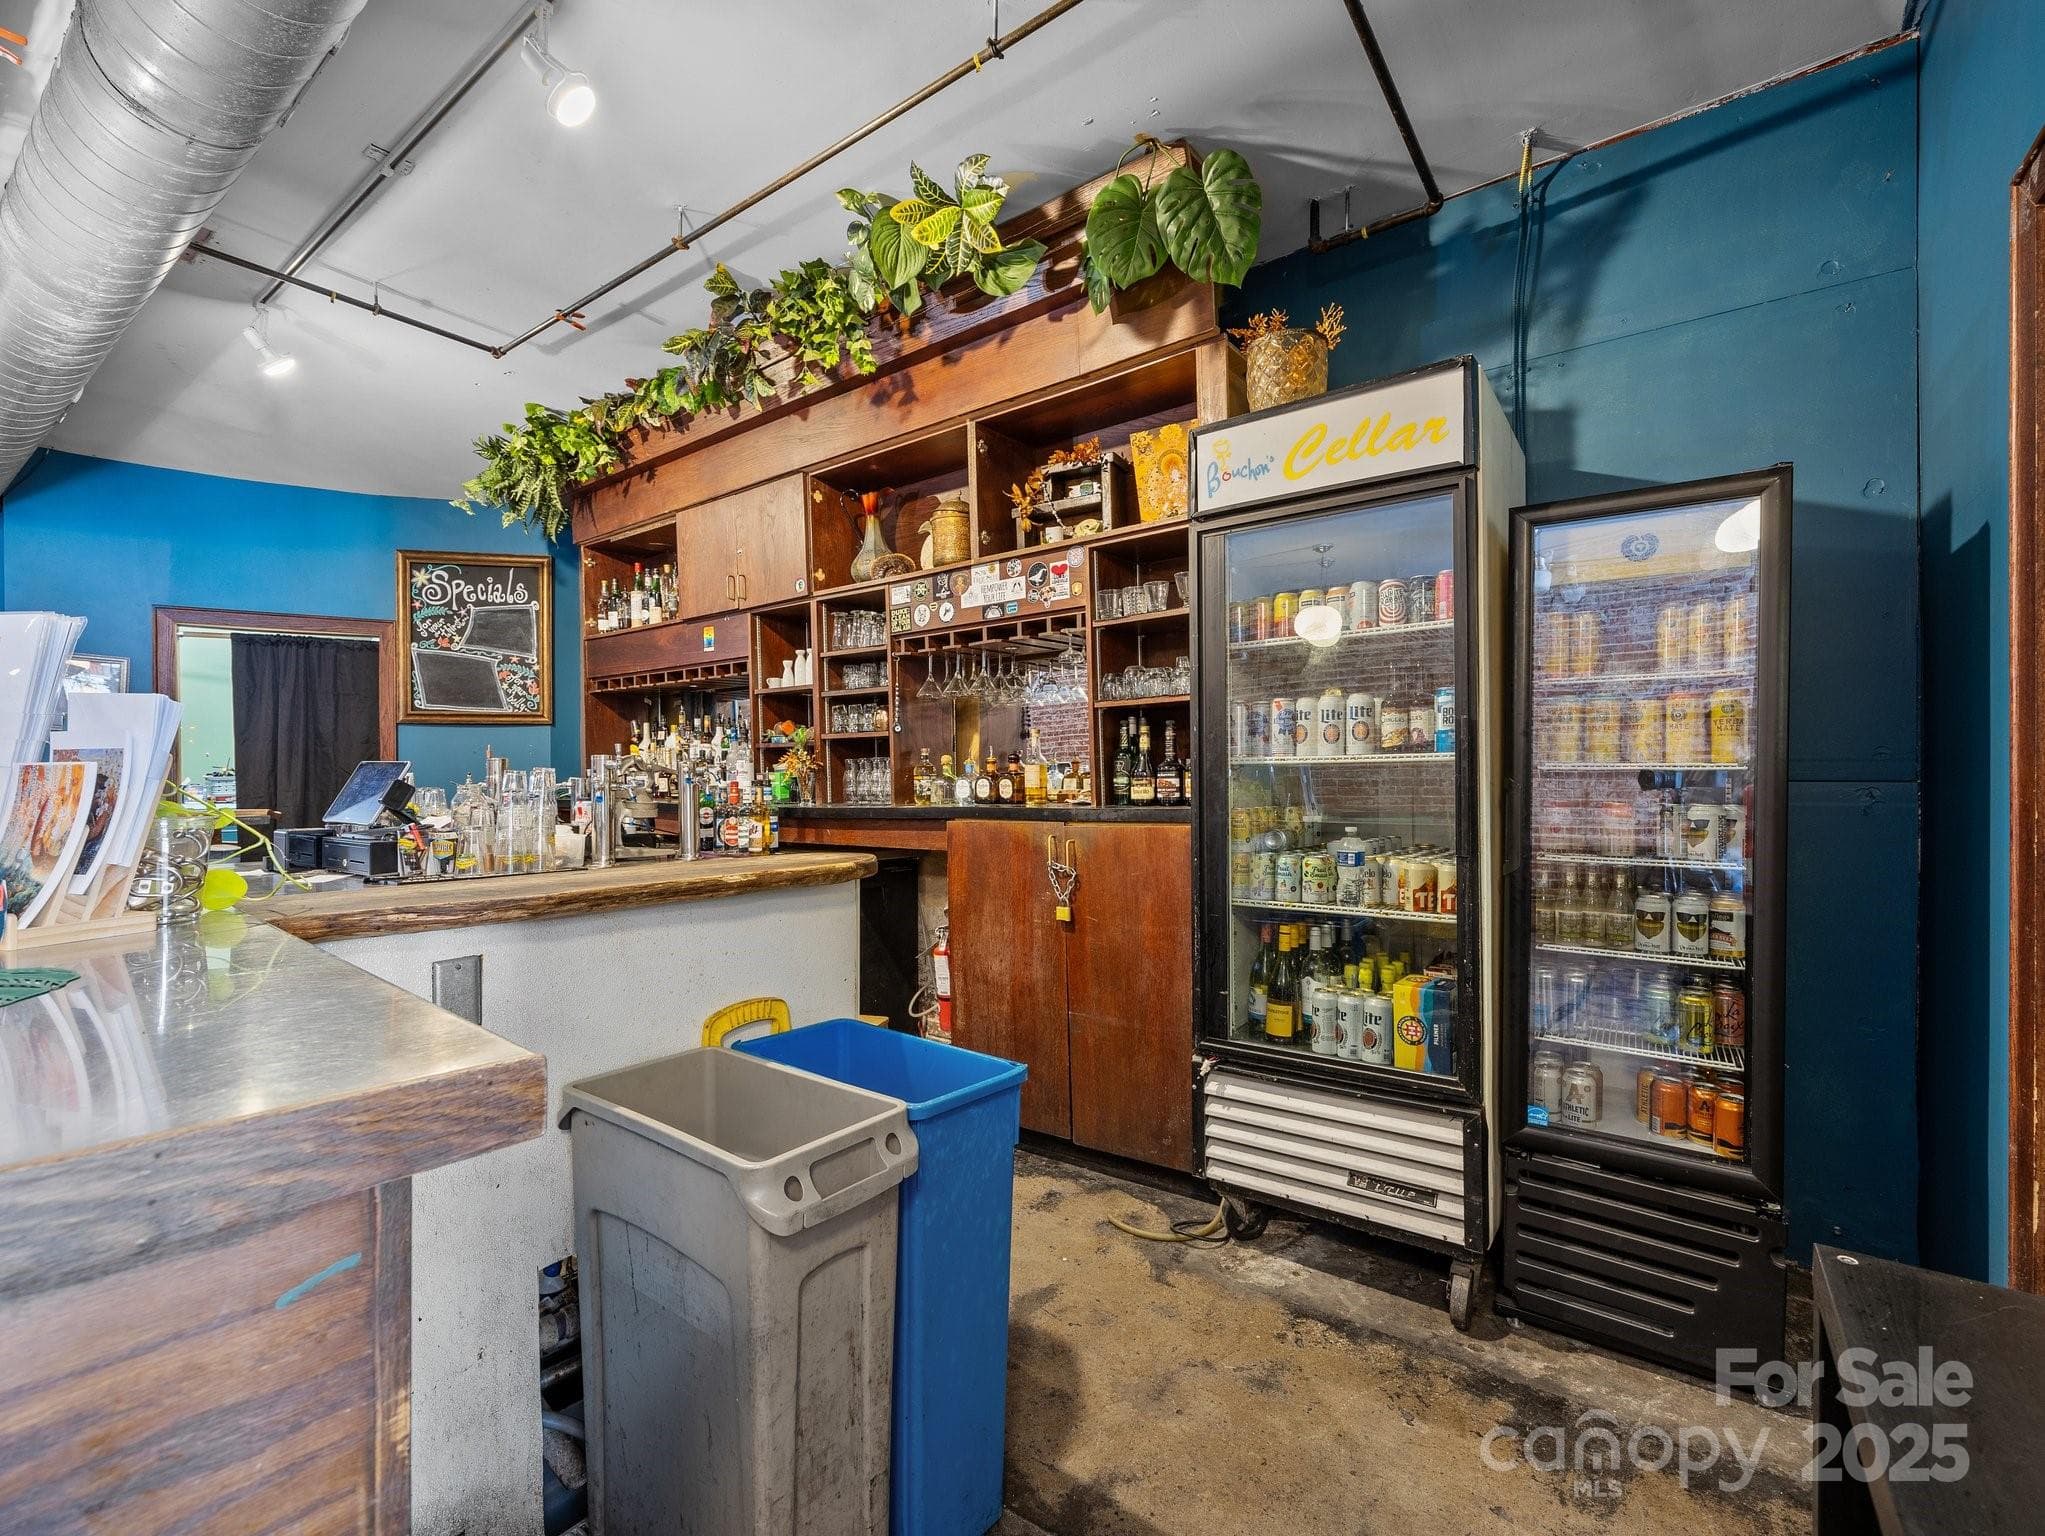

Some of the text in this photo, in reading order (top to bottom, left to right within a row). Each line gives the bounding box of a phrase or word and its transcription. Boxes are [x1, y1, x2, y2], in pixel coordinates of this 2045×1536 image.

[1283, 410, 1449, 481] Cellar
[422, 568, 529, 611] Specials
[1296, 709, 1311, 721] ite
[1321, 709, 1343, 723] Lite
[1349, 705, 1374, 721] Lite
